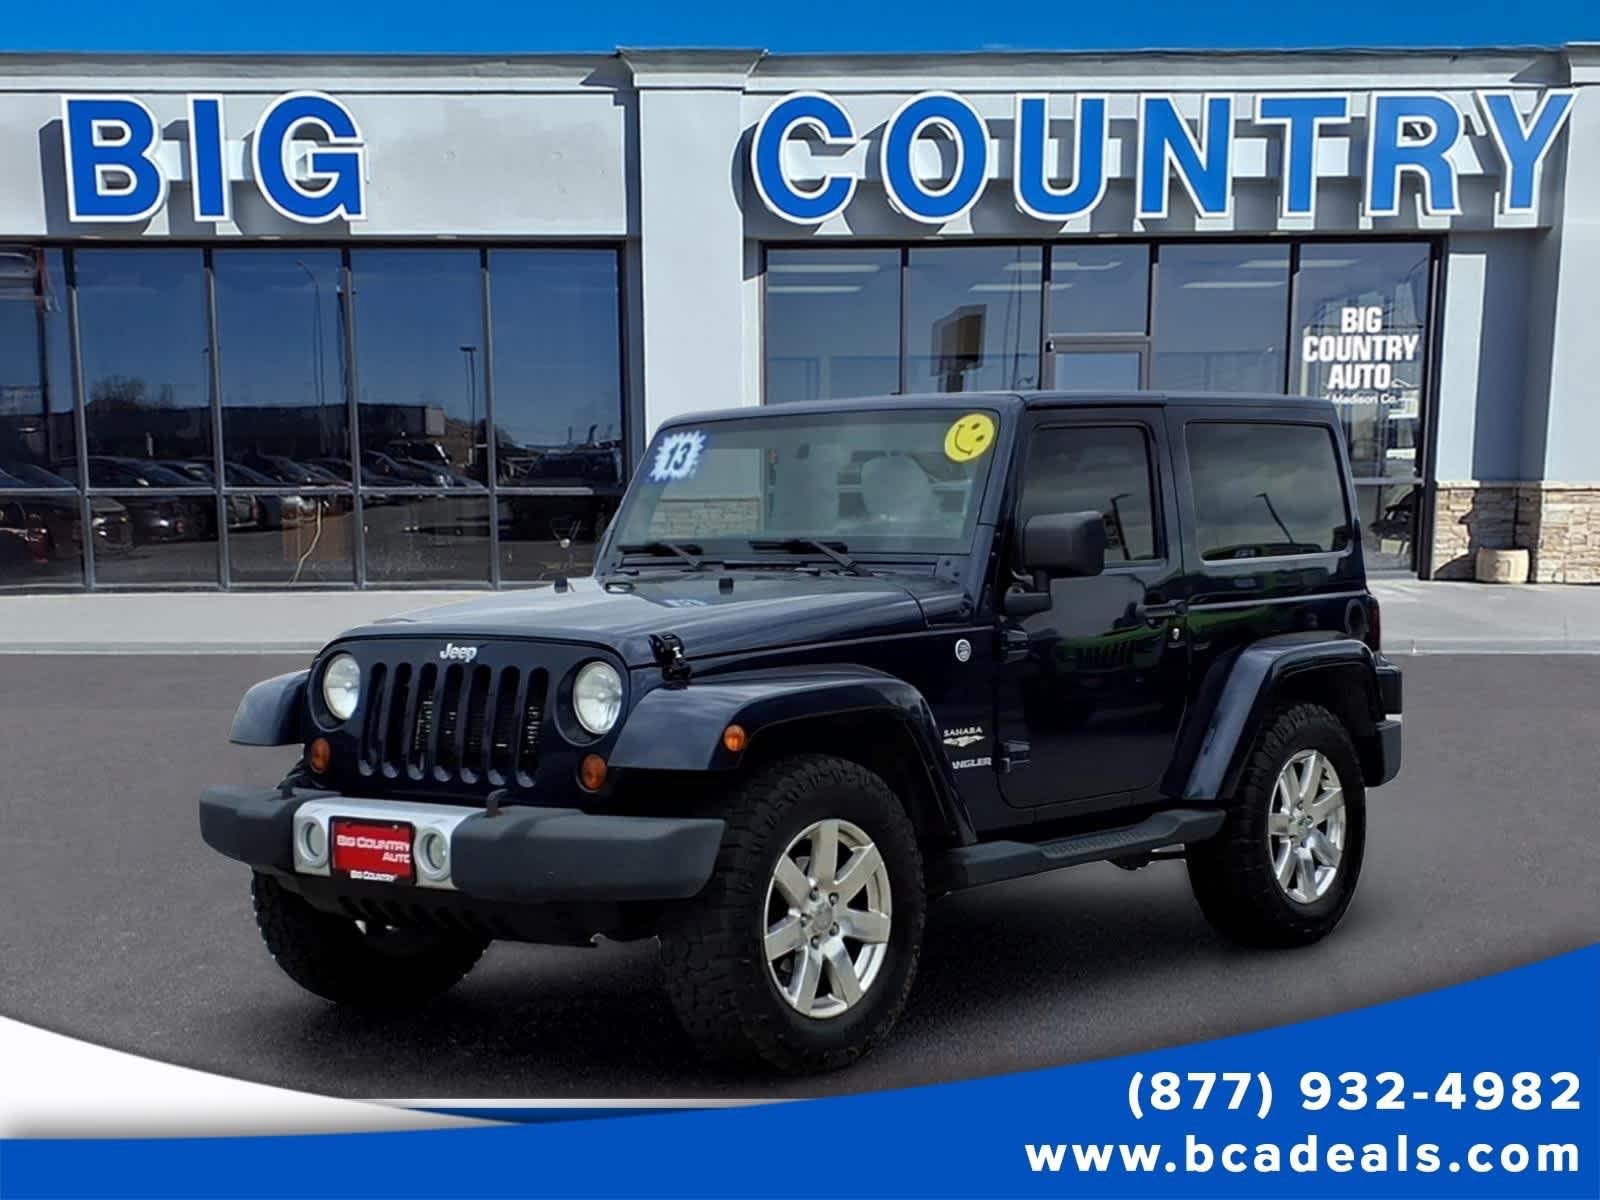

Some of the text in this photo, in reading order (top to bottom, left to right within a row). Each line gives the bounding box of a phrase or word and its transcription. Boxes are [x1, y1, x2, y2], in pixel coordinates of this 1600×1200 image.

[61, 89, 1575, 225] BIG COUNTRY
[1340, 306, 1383, 334] BIG
[1302, 335, 1419, 362] COUNTRY
[1327, 363, 1391, 390] AUTO
[663, 441, 692, 471] 13
[440, 643, 477, 663] Jeep
[356, 837, 410, 851] COUNTRY
